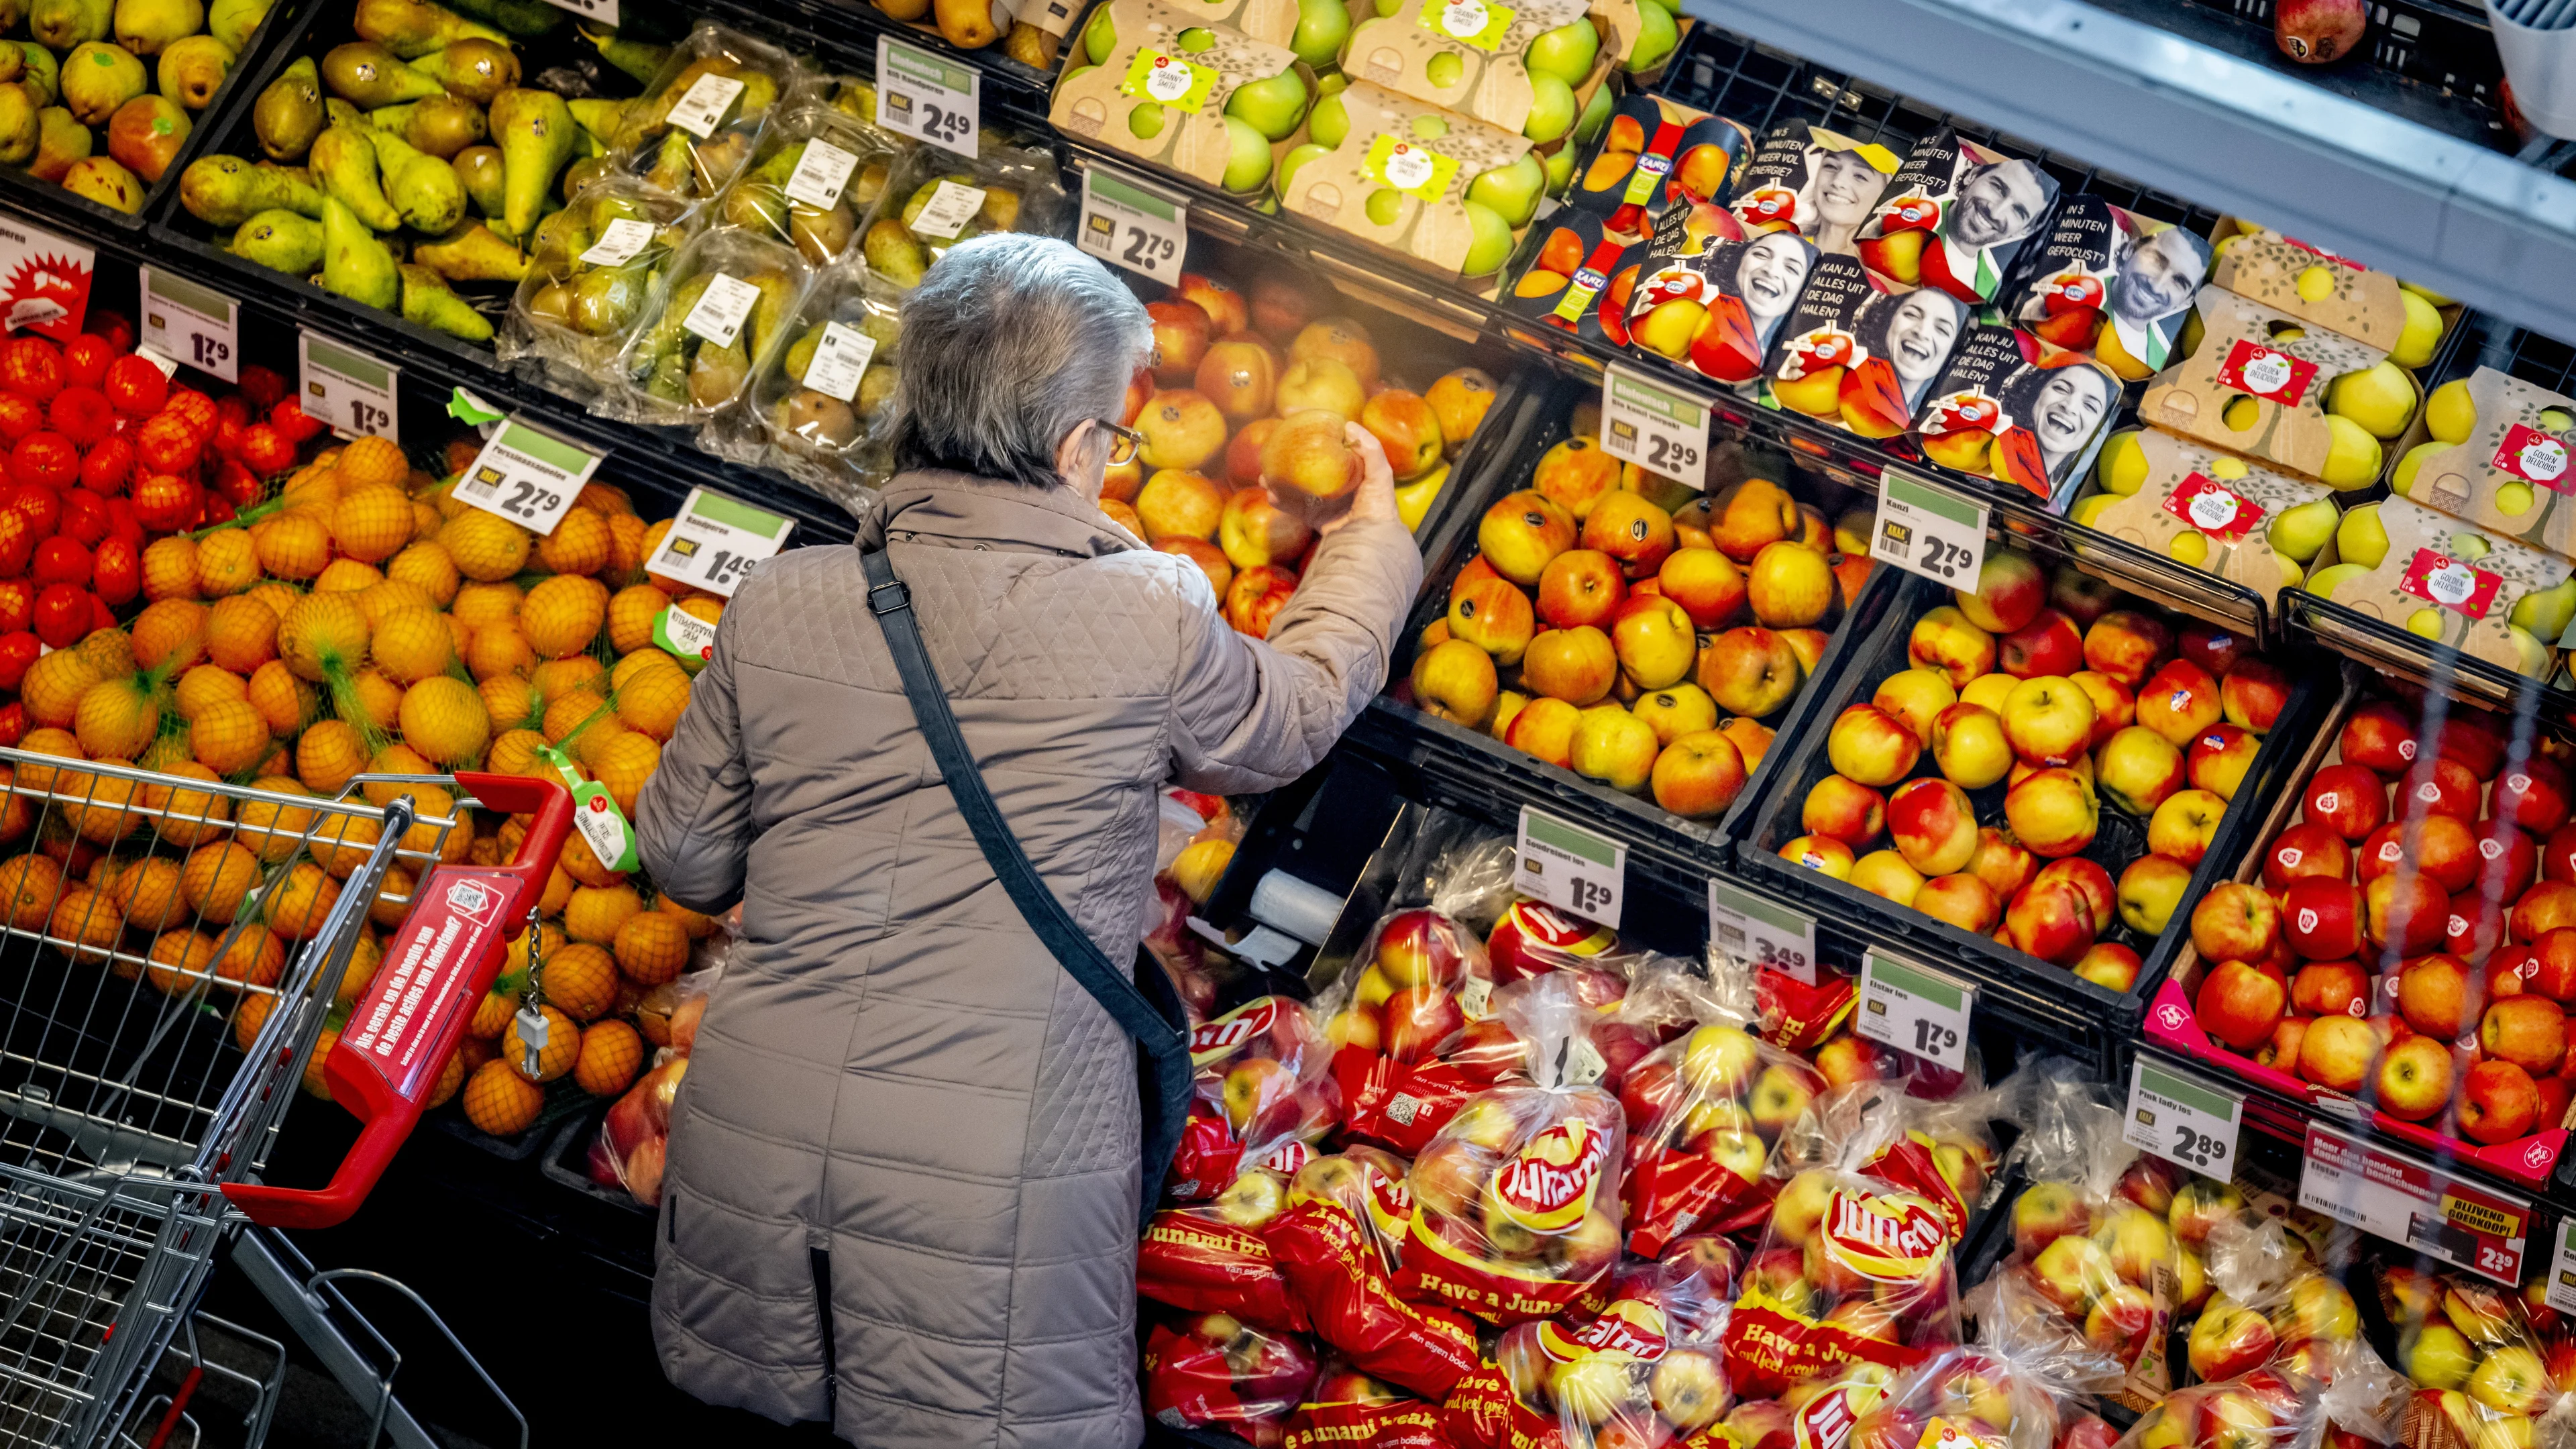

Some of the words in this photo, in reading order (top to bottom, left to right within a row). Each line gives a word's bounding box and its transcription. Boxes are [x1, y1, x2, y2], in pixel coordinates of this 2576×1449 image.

[1452, 7, 1481, 21] GRANNY
[1452, 15, 1473, 28] SMITH
[1157, 79, 1177, 91] SMITH
[1158, 70, 1185, 84] GRANNY
[923, 103, 970, 143] 2.49
[1764, 140, 1806, 152] MINUTEN
[1920, 136, 1931, 145] IN
[1929, 136, 1937, 144] 5
[1639, 154, 1670, 172] KANZI
[1756, 152, 1782, 163] WEER
[1782, 153, 1800, 165] VOL
[1911, 148, 1953, 161] MINUTEN
[1749, 165, 1793, 177] ENERGIE?
[1903, 160, 1928, 170] WEER
[1894, 172, 1947, 189] GEFOCUST?
[1902, 209, 1919, 220] KANZI
[2066, 205, 2078, 215] IN
[2078, 204, 2086, 215] 5
[1658, 213, 1677, 233] ALLES
[1678, 207, 1690, 221] UIT
[2060, 219, 2107, 233] MINUTEN
[1654, 234, 1666, 246] DE
[1667, 227, 1680, 242] DAG
[2054, 232, 2082, 244] WEER
[1122, 225, 1175, 270] 2.79
[1649, 241, 1681, 259] HALEN?
[2047, 246, 2106, 265] GEFOCUST?
[1820, 262, 1844, 275] KAN
[1843, 266, 1861, 278] JIJ
[1574, 271, 1606, 288] KANZI
[1813, 276, 1846, 290] ALLES
[1847, 282, 1867, 295] UIT
[1807, 290, 1823, 301] DE
[1821, 291, 1844, 305] DAG
[1800, 303, 1841, 319] HALEN?
[191, 331, 229, 368] 1.79
[1974, 332, 1998, 344] KAN
[1996, 337, 2015, 349] JIJ
[1966, 344, 1999, 358] ALLES
[1999, 351, 2019, 364] UIT
[1957, 356, 1974, 366] DE
[1972, 357, 1995, 371] DAG
[2256, 362, 2282, 376] GOLDEN
[1949, 368, 1990, 383] HALEN?
[2249, 370, 2280, 385] DELICIOUS
[351, 399, 389, 435] 1.79
[1960, 408, 1979, 419] KANZI
[1648, 433, 1698, 474] 2.99
[2532, 449, 2559, 465] GOLDEN
[2526, 455, 2557, 473] DELICIOUS
[500, 479, 561, 519] 2.79
[1886, 498, 1909, 514] Kanzi
[2204, 497, 2229, 515] GOLDEN
[2195, 502, 2225, 523] DELICIOUS
[1920, 535, 1974, 578] 2.79
[2433, 579, 2465, 596] DELICIOUS
[2440, 572, 2466, 588] GOLDEN
[683, 630, 700, 643] PERS
[1525, 839, 1571, 861] Goudreinet
[1572, 853, 1586, 867] los
[1570, 876, 1612, 914] 1.29
[415, 925, 435, 945] van
[422, 915, 462, 970] Nederland?
[395, 943, 424, 977] hoogte
[460, 947, 471, 959] scan
[1755, 936, 1807, 971] 3.49
[389, 975, 406, 990] de
[415, 967, 433, 987] van
[447, 974, 456, 983] op
[383, 988, 399, 1004] op
[1870, 979, 1894, 995] Elstar
[1894, 989, 1909, 1001] los
[398, 985, 423, 1016] acties
[428, 1004, 439, 1014] Dirk
[366, 1002, 390, 1033] eerste
[420, 1018, 431, 1030] voor
[425, 1012, 434, 1020] de
[381, 1014, 407, 1042] beste
[415, 1032, 423, 1040] nu
[1914, 1018, 1958, 1056] 1.79
[355, 1032, 375, 1049] Als
[376, 1041, 392, 1057] de
[410, 1037, 420, 1048] dan
[399, 1050, 413, 1067] Schrijf
[1449, 1085, 1472, 1100] bode
[2139, 1088, 2157, 1102] Pink
[2158, 1095, 2178, 1112] lady
[2178, 1104, 2192, 1116] los
[2172, 1125, 2227, 1167] 2.89
[2313, 1136, 2340, 1154] Meer
[2341, 1147, 2361, 1163] dan
[2361, 1155, 2404, 1179] honderd
[2310, 1161, 2341, 1179] Elstar
[2312, 1146, 2364, 1173] dagelijkse
[2365, 1164, 2438, 1201] boodschappen
[2453, 1199, 2506, 1223] BLIJVEND
[1833, 1193, 1941, 1252] Junam
[2447, 1208, 2512, 1237] GOEDKOOP!
[1142, 1222, 1233, 1252] Junami
[2480, 1246, 2515, 1273] 2.39
[1225, 1263, 1242, 1274] Van
[1244, 1267, 1273, 1279] eigen
[1418, 1273, 1481, 1301] Have
[1485, 1293, 1500, 1307] a
[1505, 1293, 1564, 1316] Juna
[1424, 1337, 1448, 1358] eigen
[1742, 1323, 1801, 1356] Have
[1804, 1342, 1816, 1357] a
[1758, 1350, 1784, 1373] feel
[1460, 1395, 1481, 1414] feel
[1483, 1401, 1506, 1417] gre
[1301, 1429, 1315, 1443] a
[1313, 1418, 1379, 1443] unami
